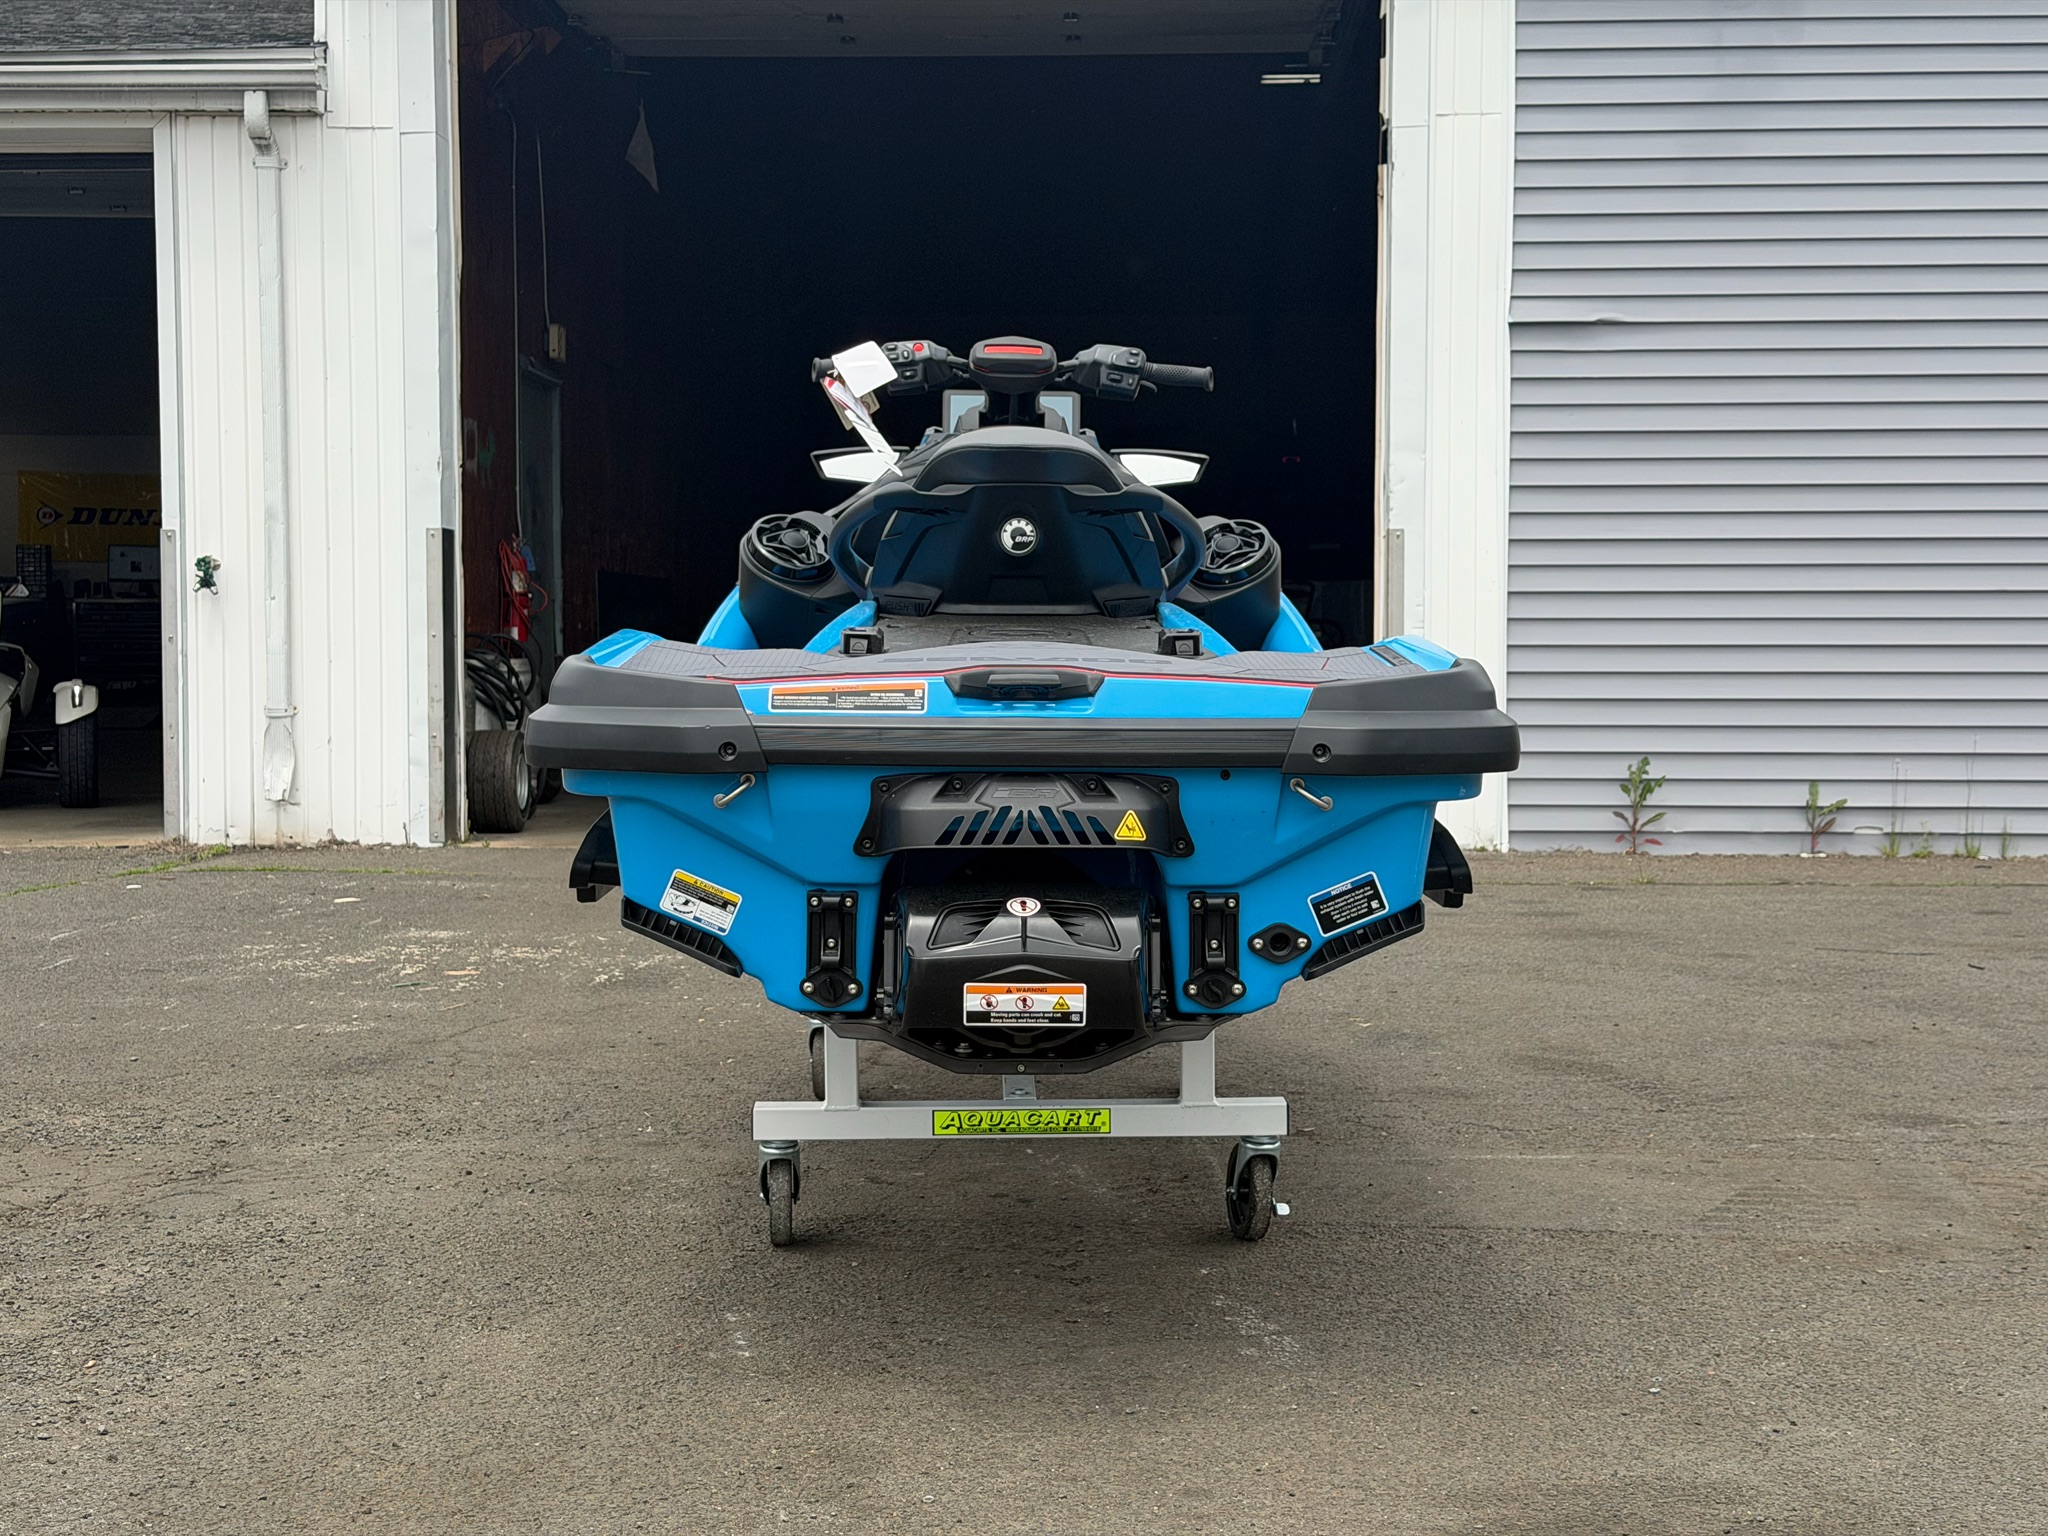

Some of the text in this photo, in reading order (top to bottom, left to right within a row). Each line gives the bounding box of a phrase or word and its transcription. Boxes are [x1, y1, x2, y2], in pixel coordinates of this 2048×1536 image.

[67, 507, 160, 525] DUN
[700, 880, 725, 896] CAUTION
[1331, 883, 1352, 895] NOTICE
[940, 1111, 1102, 1130] AQUACART
